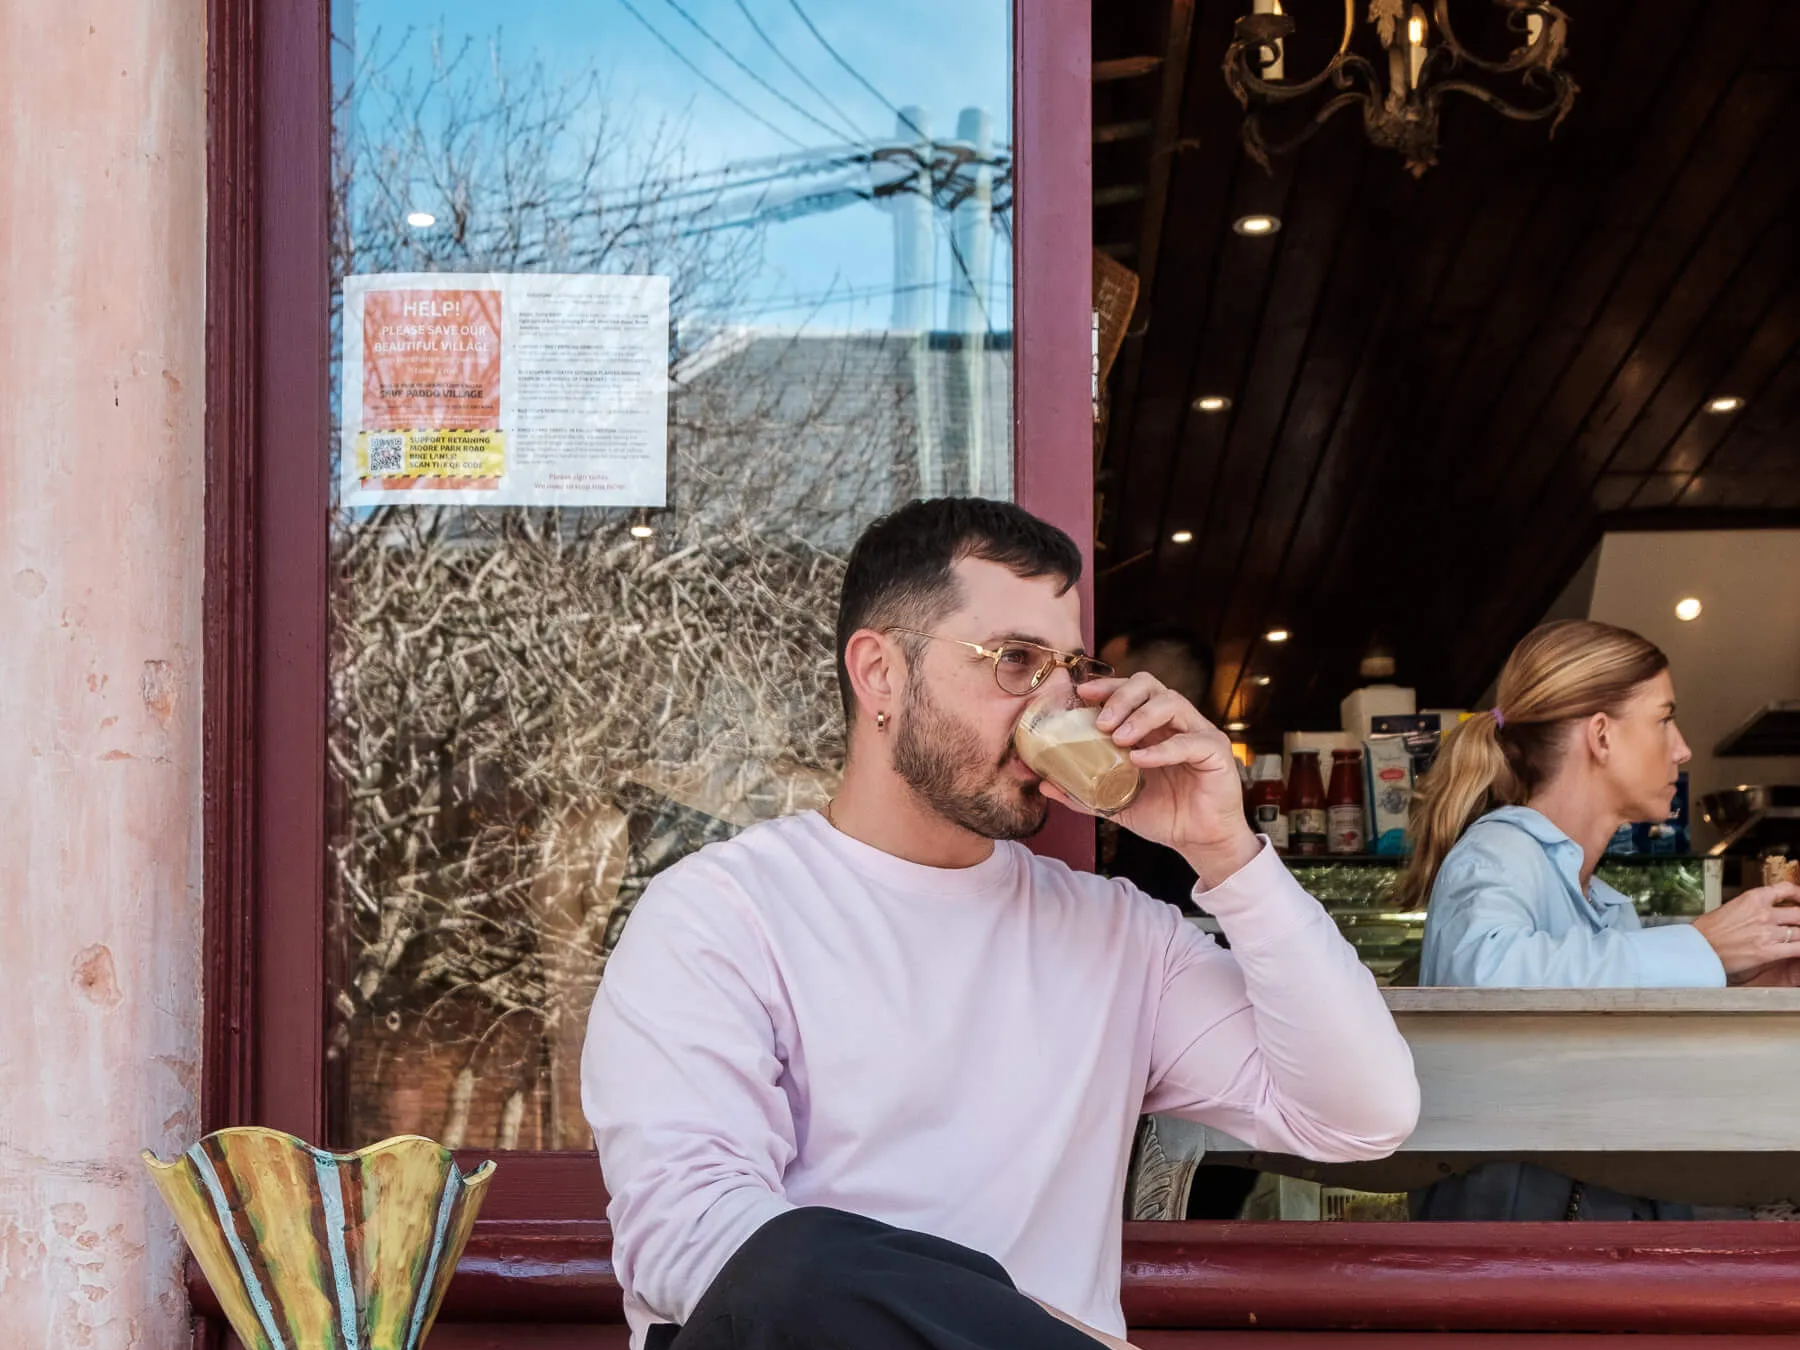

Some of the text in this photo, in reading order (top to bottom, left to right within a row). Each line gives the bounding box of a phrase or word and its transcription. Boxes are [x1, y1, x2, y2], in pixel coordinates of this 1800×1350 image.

[403, 300, 460, 316] HELP!
[382, 325, 487, 336] PLEASE SAVE OUR
[374, 341, 490, 352] BEAUTIFUL VILLAGE
